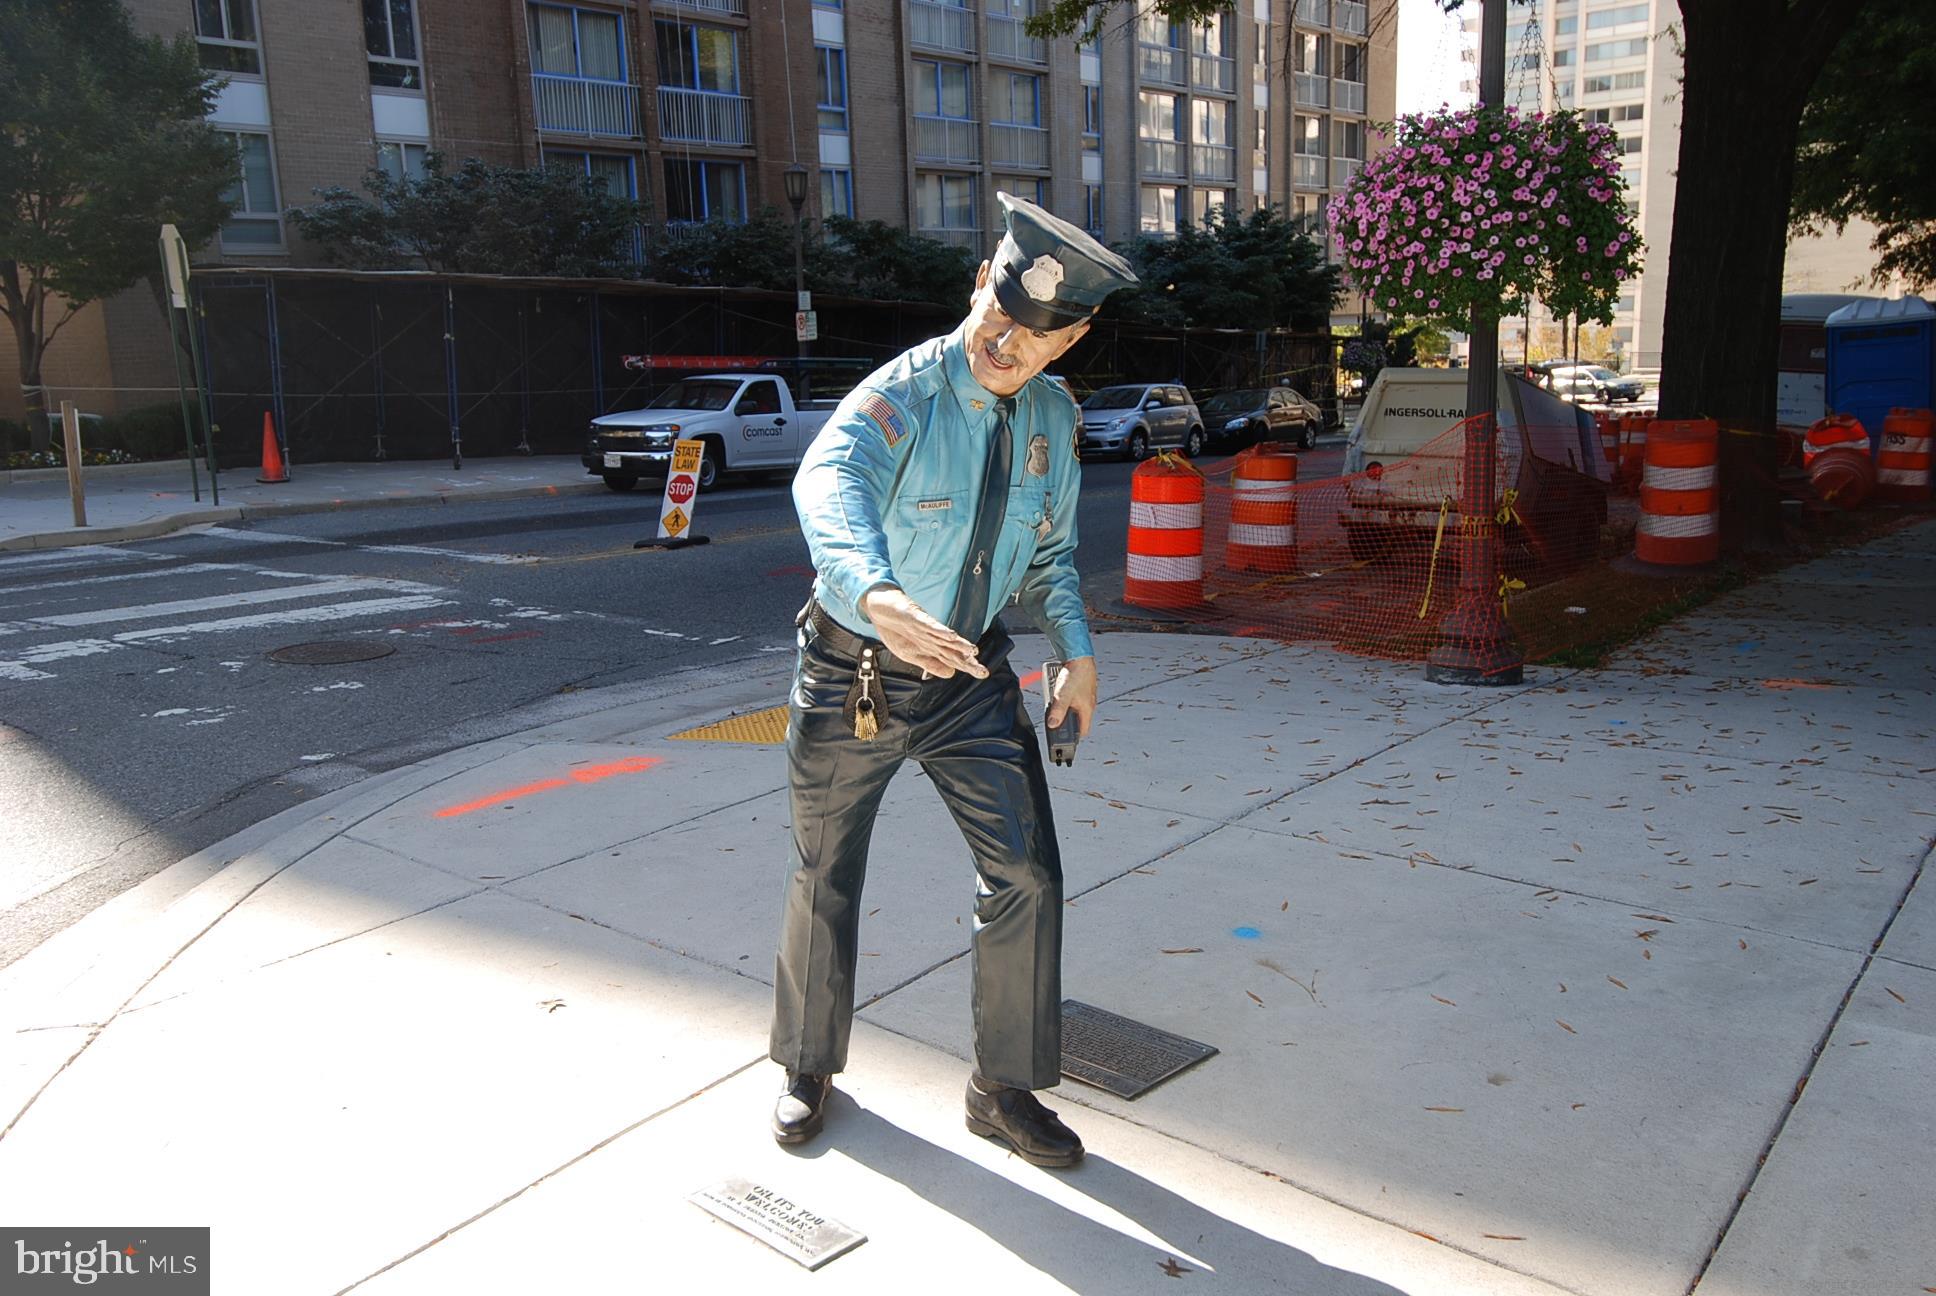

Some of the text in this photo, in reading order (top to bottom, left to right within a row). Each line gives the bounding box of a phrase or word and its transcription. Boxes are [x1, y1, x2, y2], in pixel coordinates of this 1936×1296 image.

[675, 446, 701, 458] STATE
[676, 458, 696, 470] LAW
[669, 482, 695, 496] STOP
